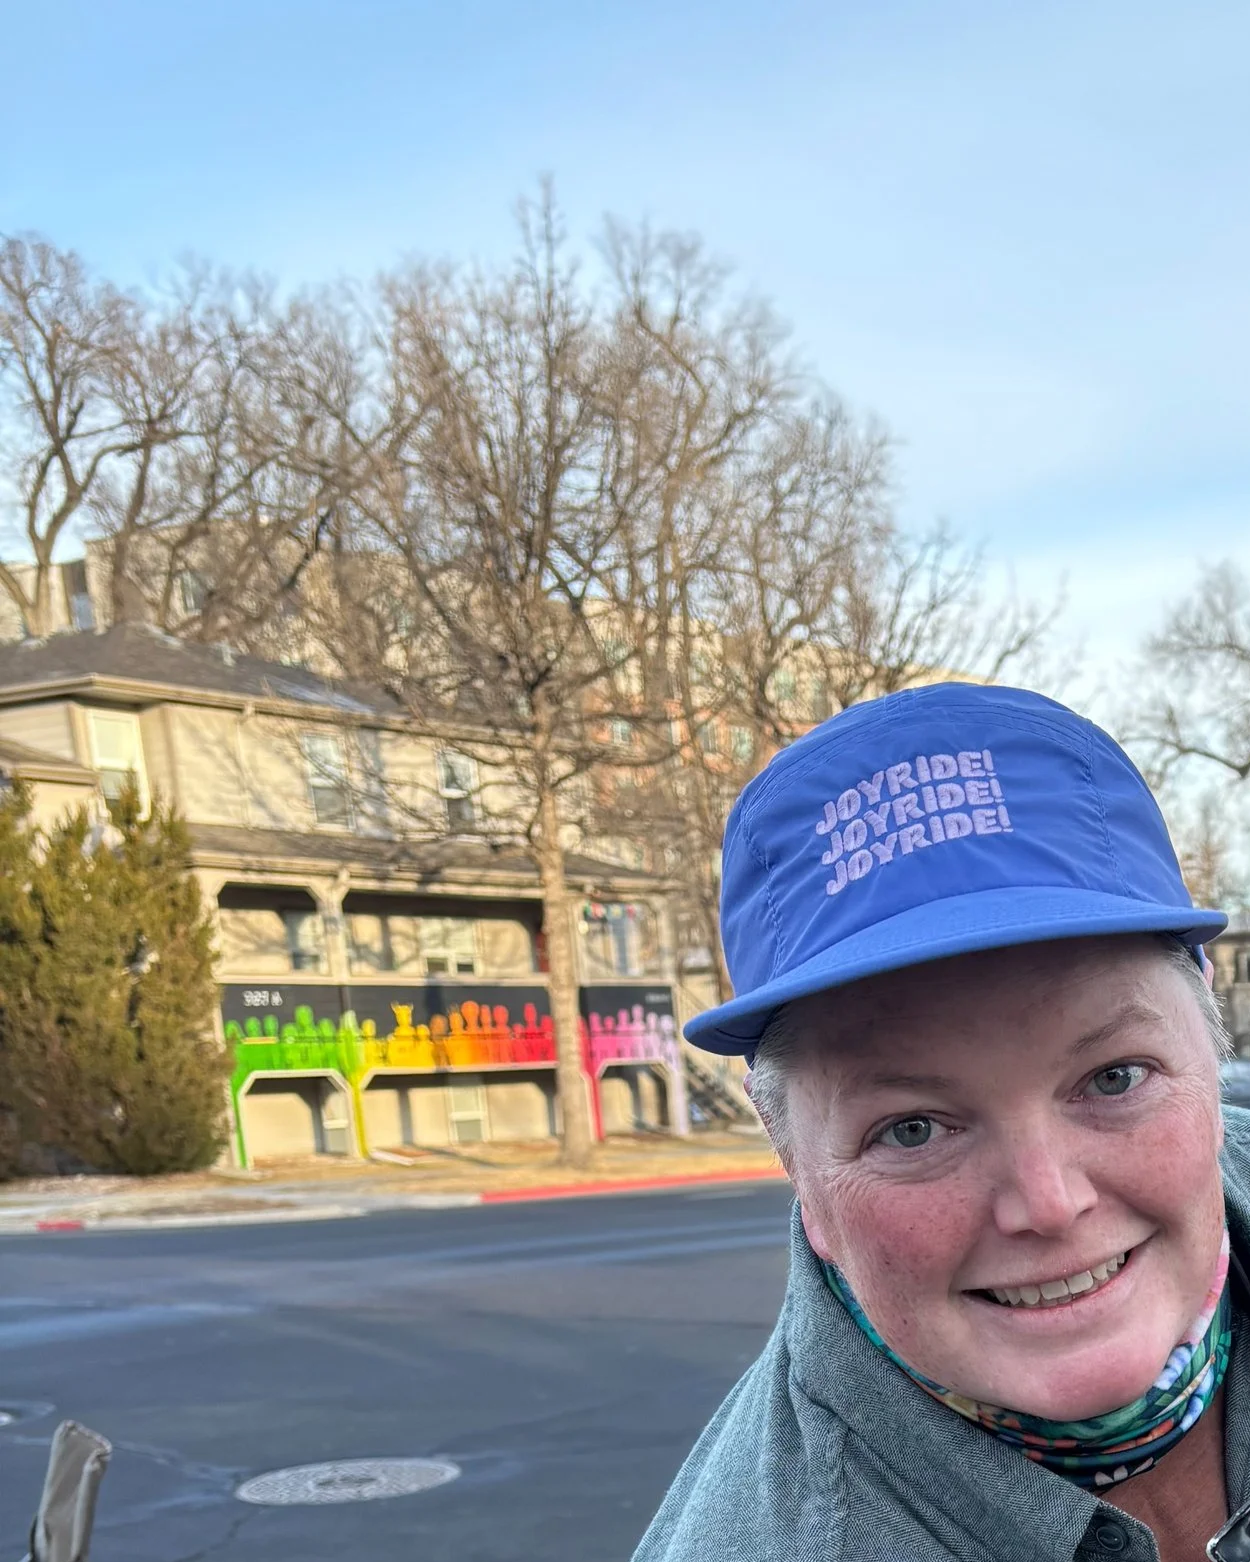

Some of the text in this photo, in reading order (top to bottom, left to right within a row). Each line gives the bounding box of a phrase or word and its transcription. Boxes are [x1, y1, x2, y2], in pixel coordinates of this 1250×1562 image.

[815, 748, 997, 836] JOYRIDE!
[821, 778, 1005, 865] JOYRIDE!
[826, 805, 1014, 896] JOYRIDE!
